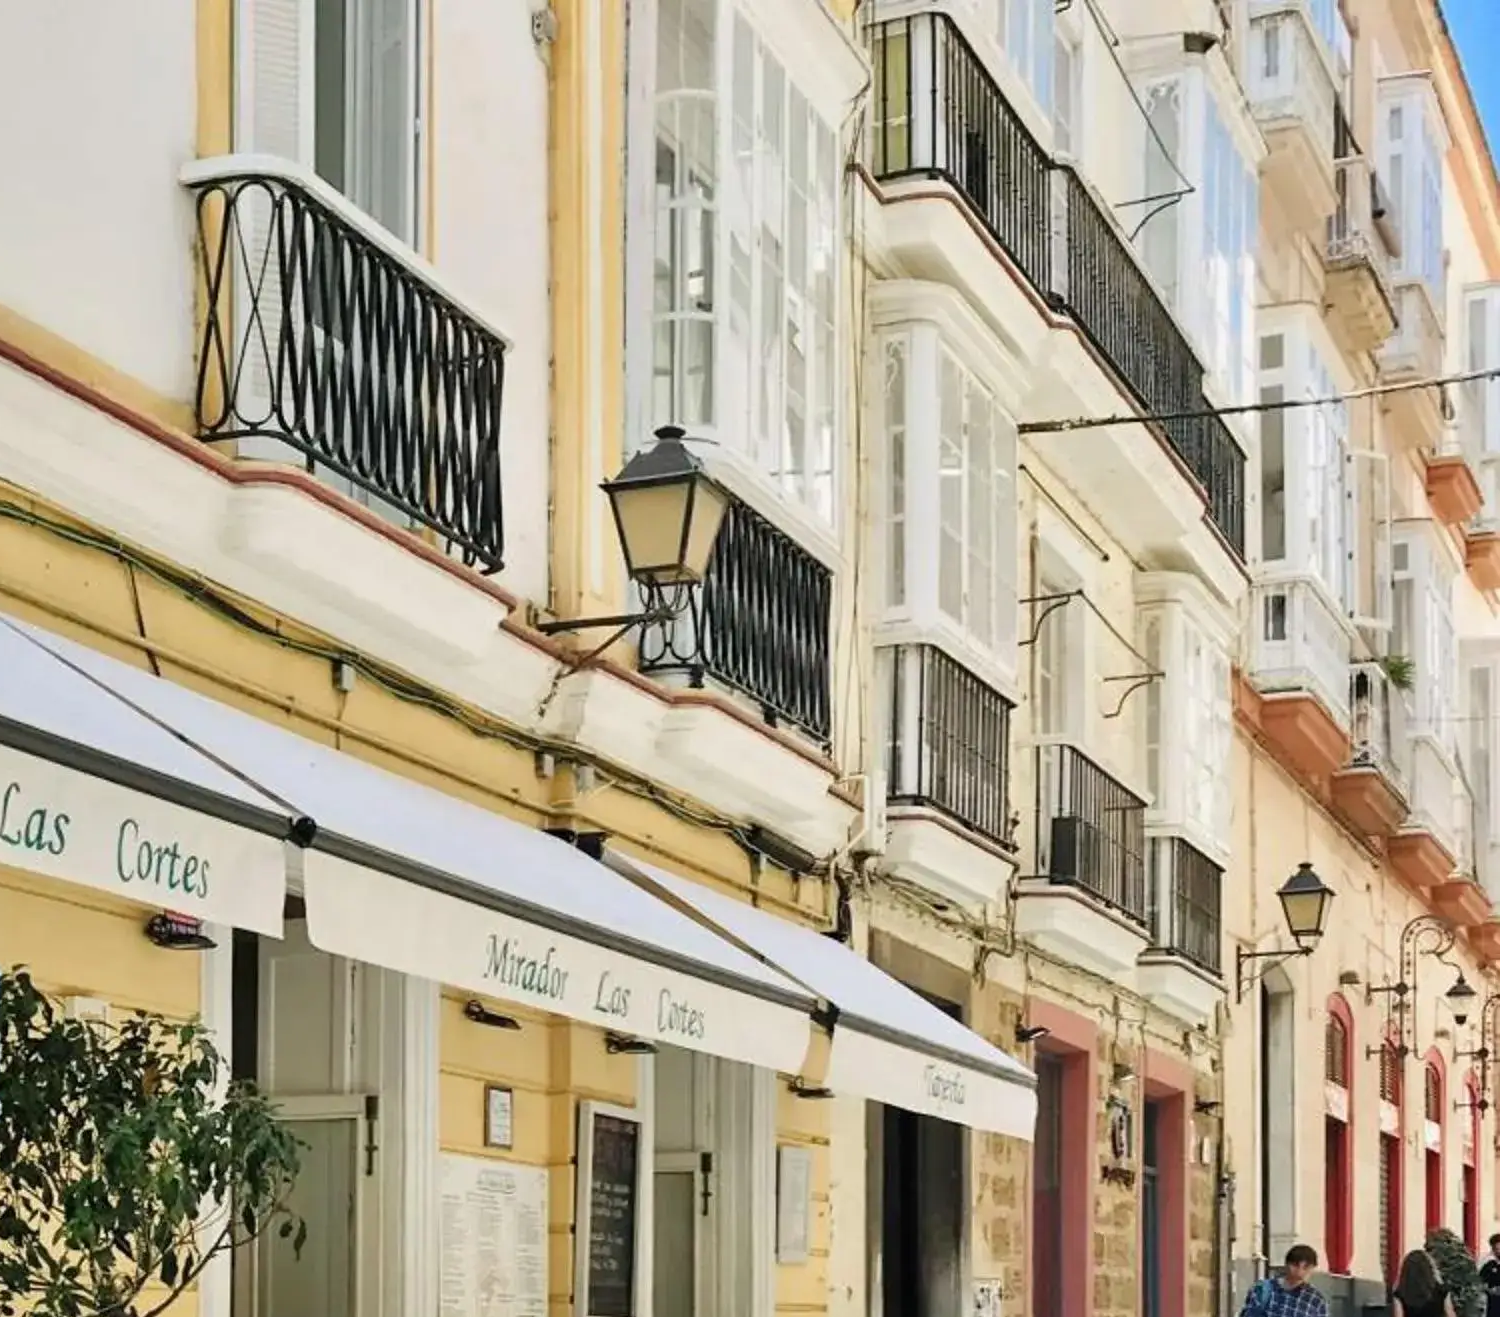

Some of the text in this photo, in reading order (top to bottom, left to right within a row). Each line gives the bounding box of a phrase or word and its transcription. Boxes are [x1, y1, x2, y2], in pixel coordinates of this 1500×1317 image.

[116, 818, 211, 899] Cortes
[482, 934, 705, 1039] Mirador Las Cortes
